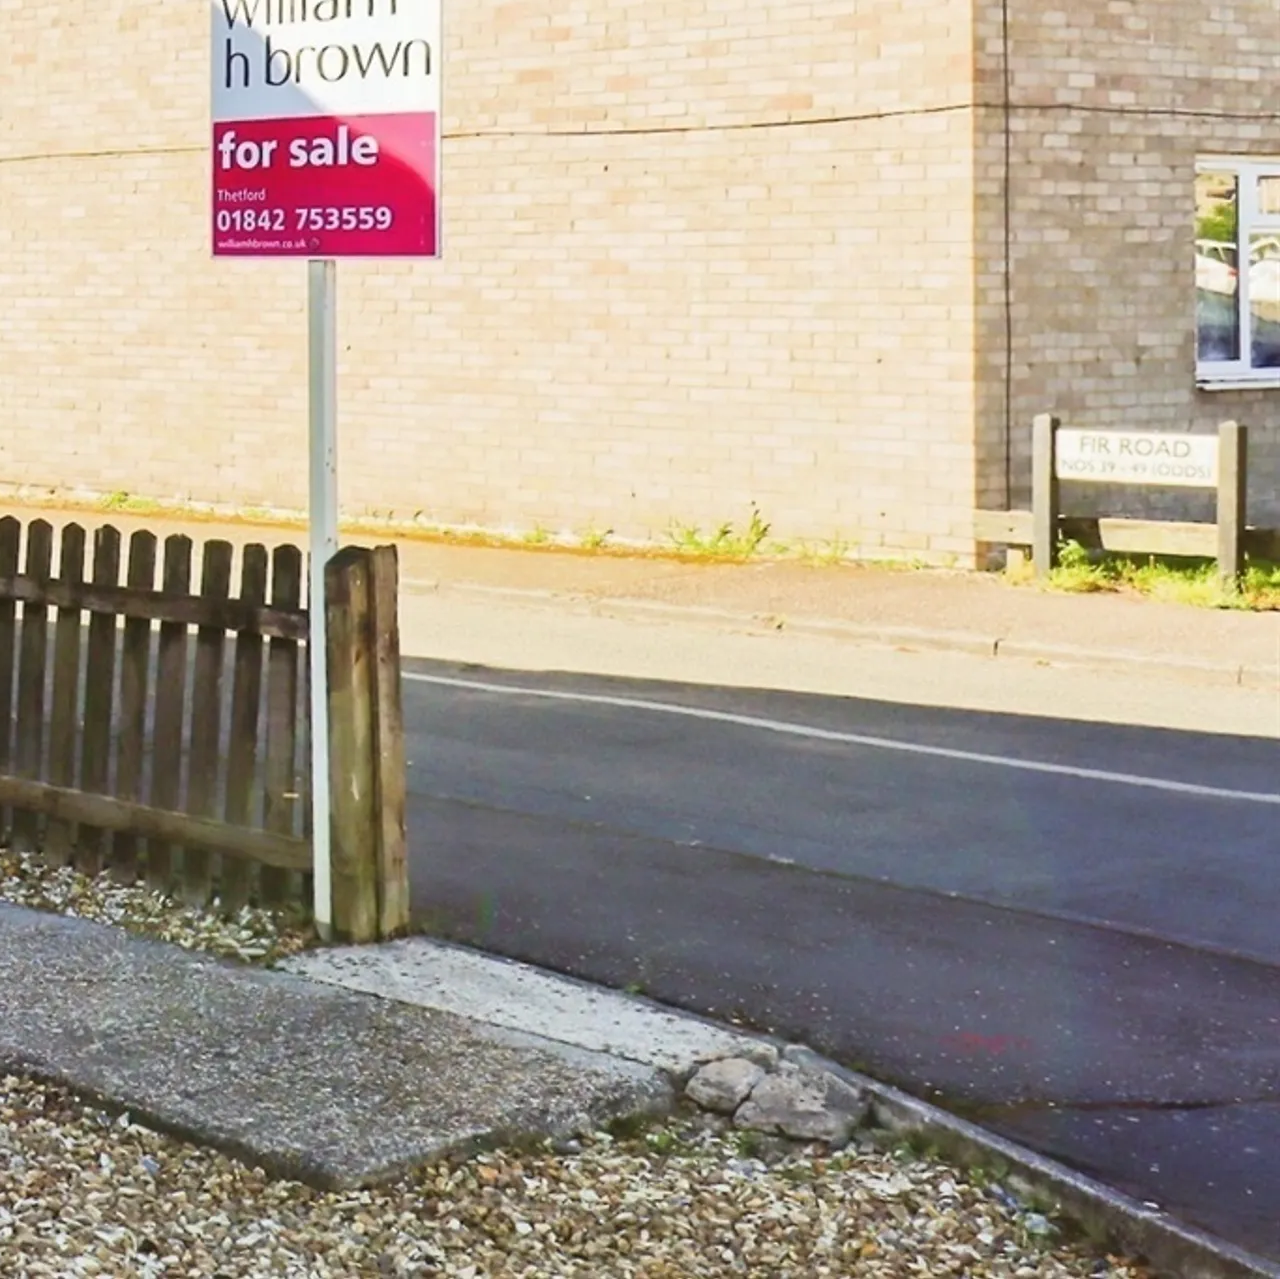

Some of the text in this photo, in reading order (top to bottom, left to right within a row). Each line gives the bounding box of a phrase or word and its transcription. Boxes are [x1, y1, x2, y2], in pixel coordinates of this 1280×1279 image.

[225, 35, 431, 89] h brown
[218, 126, 378, 170] for sale
[217, 188, 267, 202] Thetford
[217, 206, 393, 231] 01842 753559
[217, 238, 307, 249] williamhbrown.co.uk
[1079, 436, 1191, 459] FIR ROAD
